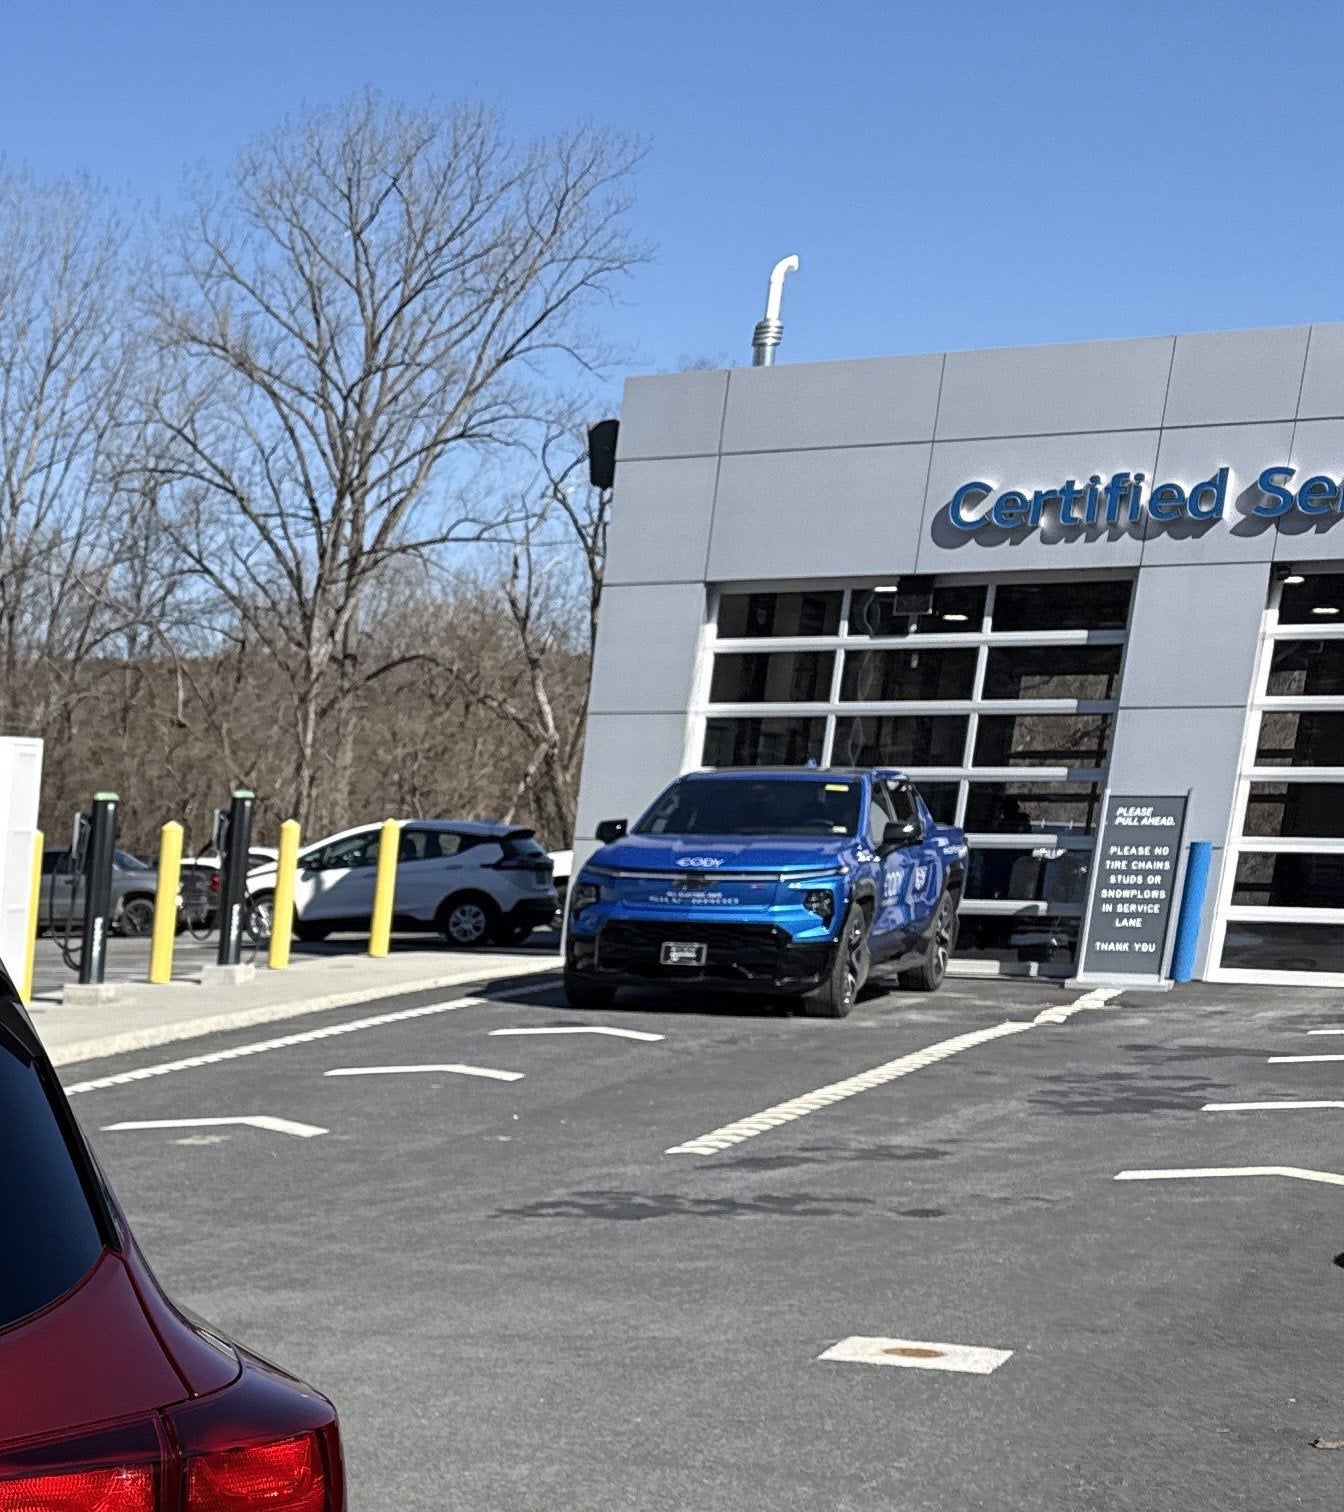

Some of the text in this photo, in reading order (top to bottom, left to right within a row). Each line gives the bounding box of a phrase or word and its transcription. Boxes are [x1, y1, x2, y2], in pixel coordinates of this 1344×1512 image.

[948, 466, 1344, 530] Certified Se
[1116, 806, 1154, 817] PLEASE
[1115, 816, 1139, 826] PULL
[1109, 846, 1170, 856] PLEASE NO
[1105, 860, 1171, 871] TIRE CHAINS
[1109, 875, 1162, 885] STUDS OR
[1100, 889, 1166, 899] SNOWPLOWS
[1101, 903, 1161, 914] IN SERVICE
[1115, 918, 1143, 928] LANE
[1095, 941, 1156, 953] THANK YOU
